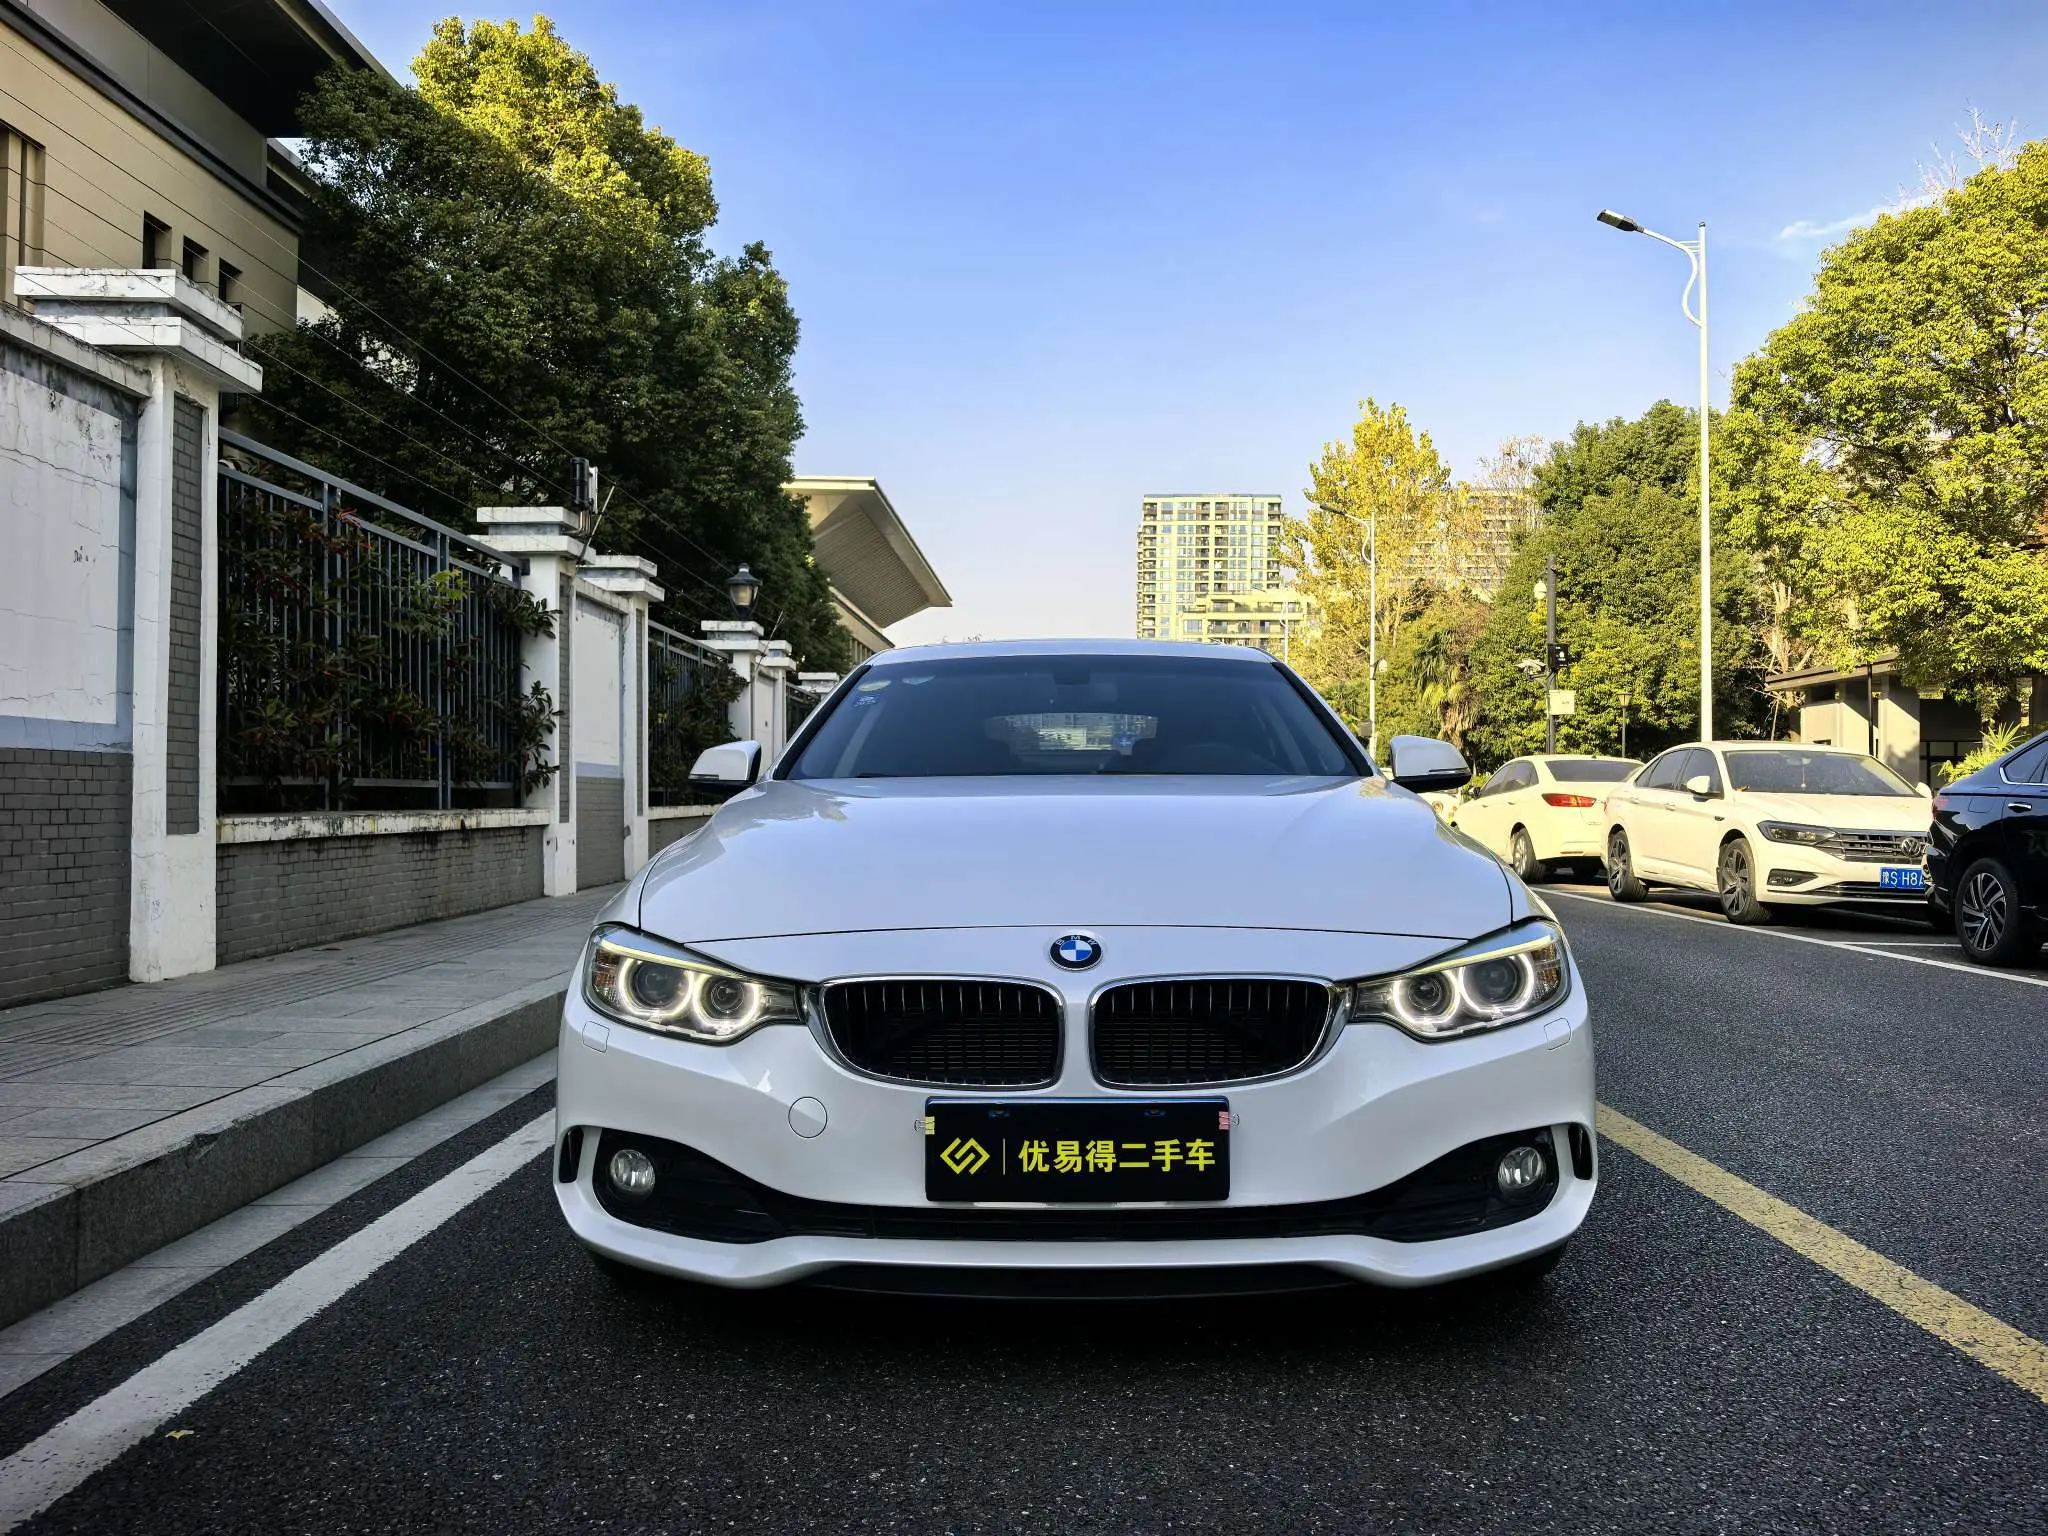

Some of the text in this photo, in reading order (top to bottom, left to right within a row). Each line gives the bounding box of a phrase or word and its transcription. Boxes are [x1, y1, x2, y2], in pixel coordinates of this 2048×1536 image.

[1018, 1138, 1216, 1174] 优易得二手车
